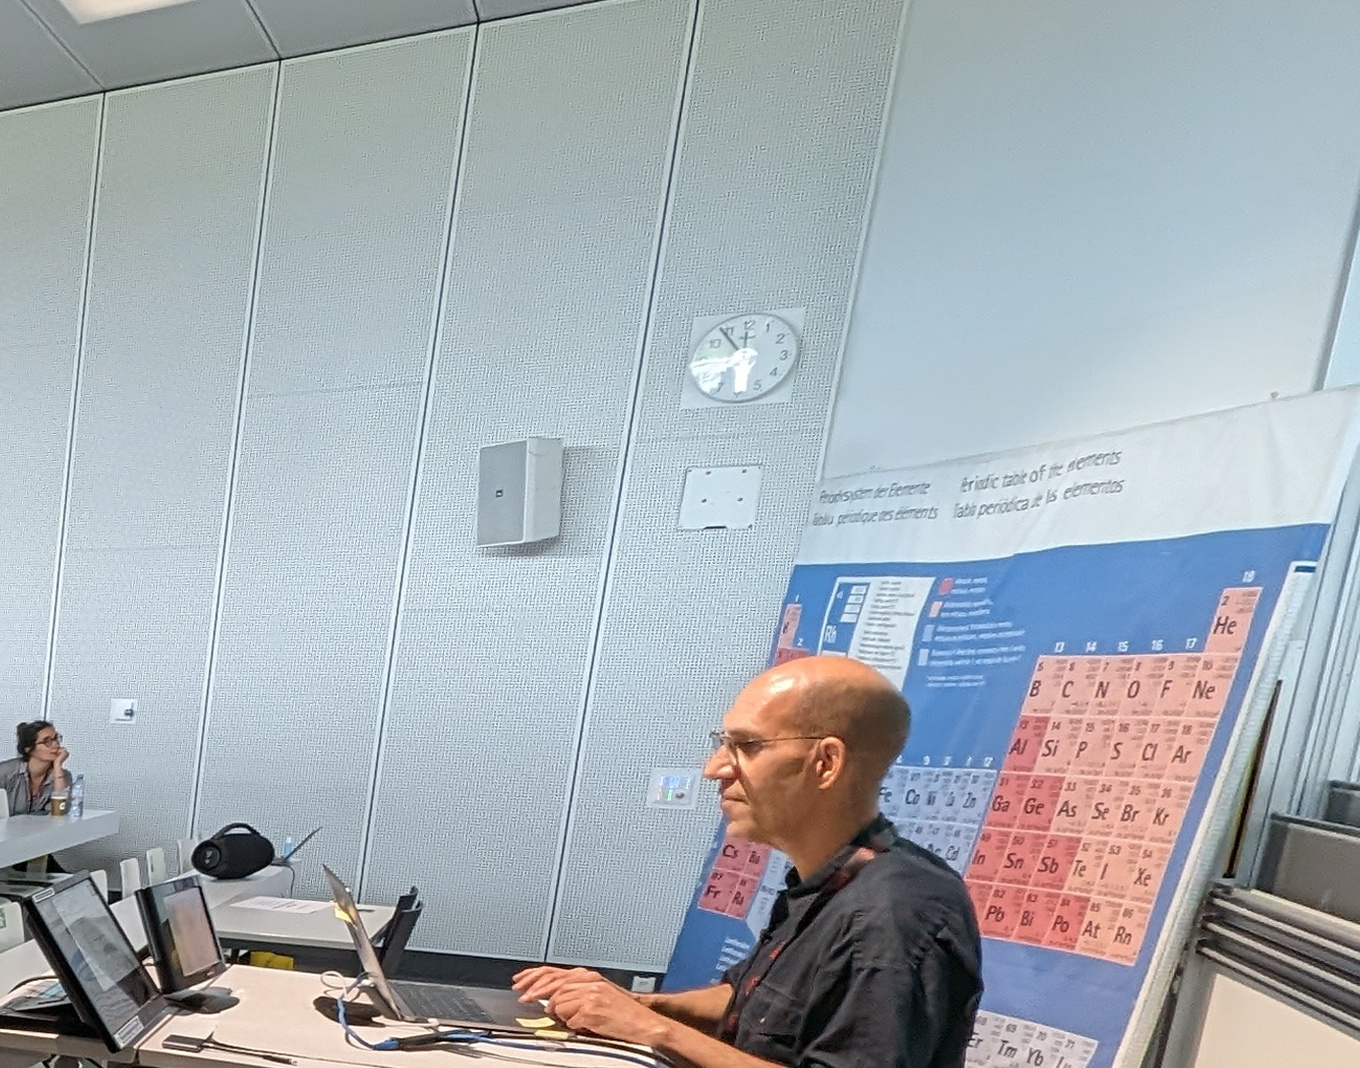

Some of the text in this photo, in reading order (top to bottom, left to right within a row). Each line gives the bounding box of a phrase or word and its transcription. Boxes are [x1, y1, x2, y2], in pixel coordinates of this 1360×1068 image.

[776, 333, 785, 344] 2
[780, 350, 788, 360] 3
[769, 367, 777, 376] 4
[754, 380, 761, 390] 5
[1029, 464, 1046, 482] of
[1243, 571, 1256, 583] 18
[1213, 616, 1237, 635] He
[1086, 641, 1097, 652] 14
[1118, 641, 1129, 652] 15
[1151, 640, 1164, 651] 16
[1186, 638, 1197, 649] 17
[1030, 680, 1216, 699] B C N O F Ne
[1009, 738, 1191, 764] Al Si P S Cl Ar
[906, 789, 920, 805] Co
[993, 796, 1010, 812] Ga
[1024, 797, 1044, 815] Ge
[1057, 801, 1077, 818] As
[1092, 803, 1110, 820] Se
[1120, 805, 1139, 823] Br
[1153, 808, 1169, 826] Kr
[722, 844, 739, 859] Cs
[1108, 845, 1122, 855] 53
[1004, 852, 1024, 869] Sn
[1038, 856, 1059, 873] Sb
[1073, 860, 1086, 878] Te
[1100, 863, 1109, 880] I
[1134, 868, 1152, 887] Xe
[704, 884, 721, 899] Fr
[985, 906, 1132, 946] Pb Bi Po At Rn
[998, 1039, 1017, 1059] Tm
[1027, 1046, 1044, 1067] Yb
